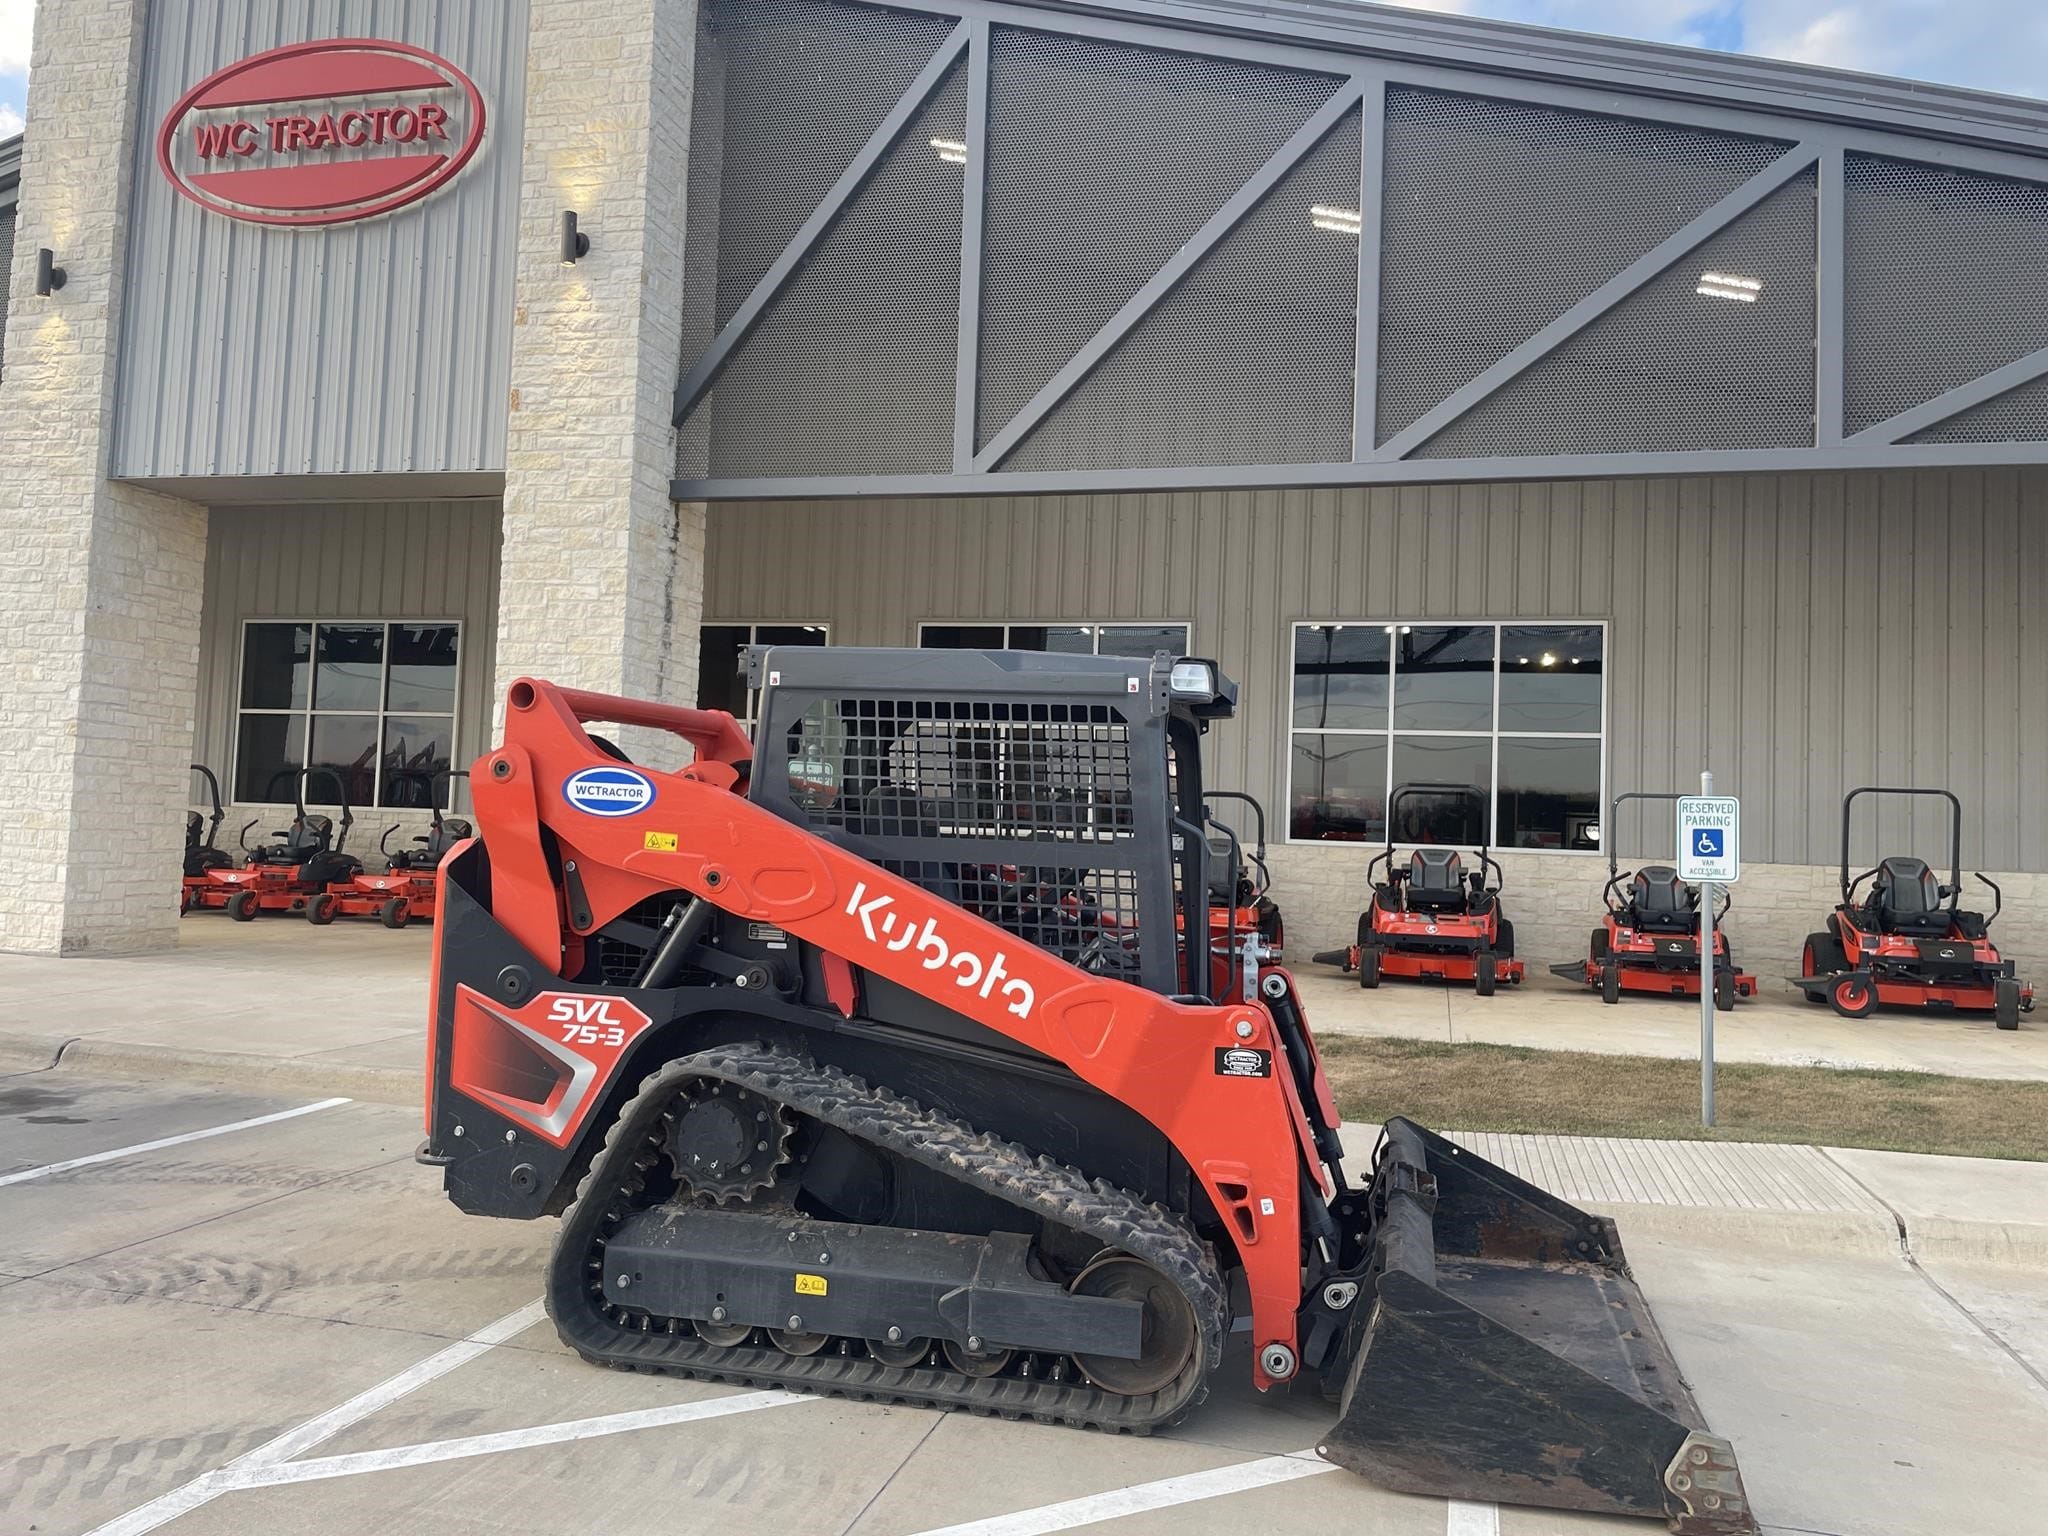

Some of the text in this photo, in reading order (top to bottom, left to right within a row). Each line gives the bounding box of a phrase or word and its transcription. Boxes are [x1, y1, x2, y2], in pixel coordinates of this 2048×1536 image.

[194, 104, 449, 160] WC TRACTOR
[1682, 803, 1734, 814] RESERVED
[1685, 815, 1731, 827] PARKING
[1689, 867, 1727, 877] ACCESSIBLE
[1702, 859, 1715, 867] VAN
[845, 881, 1035, 1020] Kubota
[547, 998, 621, 1026] SVL
[561, 1023, 625, 1047] 75-3
